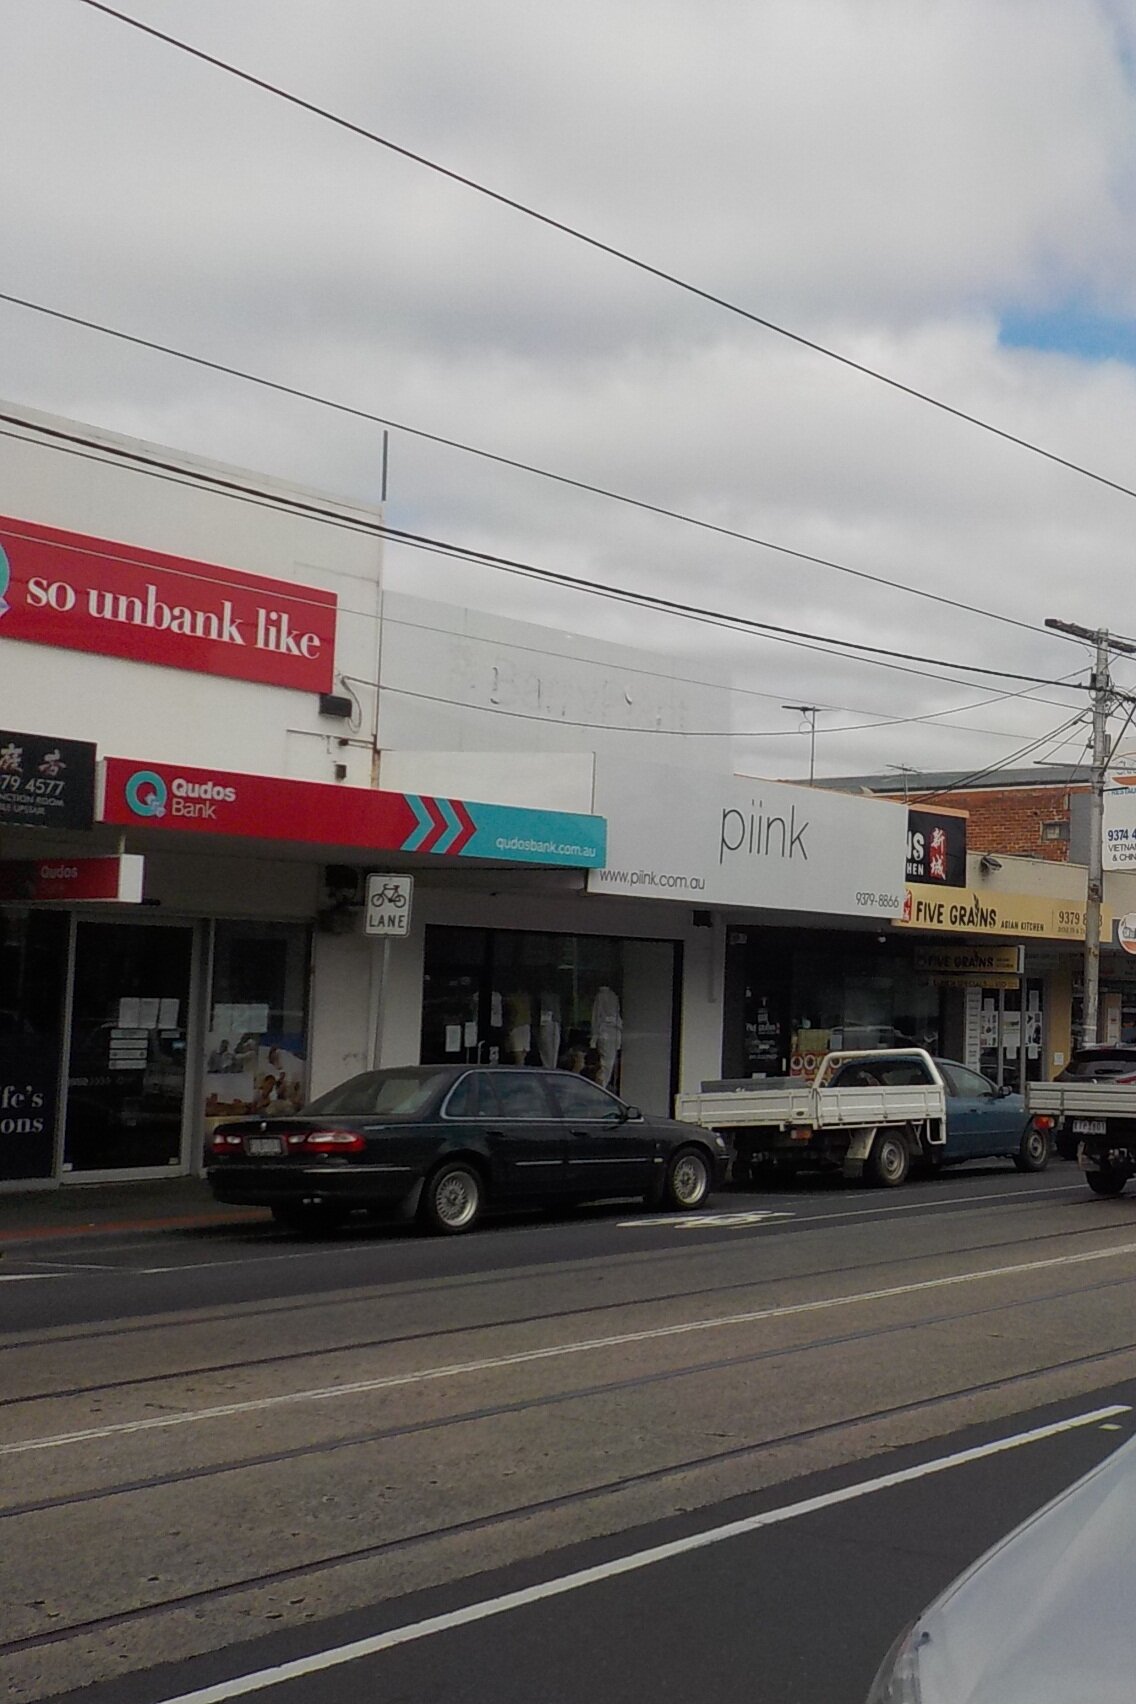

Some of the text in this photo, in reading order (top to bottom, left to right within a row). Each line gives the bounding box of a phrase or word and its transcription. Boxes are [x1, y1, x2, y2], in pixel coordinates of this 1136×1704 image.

[26, 576, 322, 660] so unbank like
[24, 778, 66, 796] 4577
[171, 777, 237, 802] Qudos
[171, 798, 218, 820] Bank
[1107, 828, 1129, 842] 9374
[495, 836, 597, 859] qudosbank.com.au
[1112, 853, 1118, 862] &
[40, 865, 78, 878] Qudos
[600, 868, 706, 891] www.piink.com.au
[855, 891, 899, 909] 9379-8866
[915, 900, 945, 924] FIVE
[950, 892, 997, 928] GRAINS
[1058, 911, 1081, 926] 9379
[368, 914, 405, 929] LANE
[1001, 920, 1045, 933] ASIAN KITCHEN
[928, 955, 952, 968] FIVE
[954, 950, 994, 969] GRAINS
